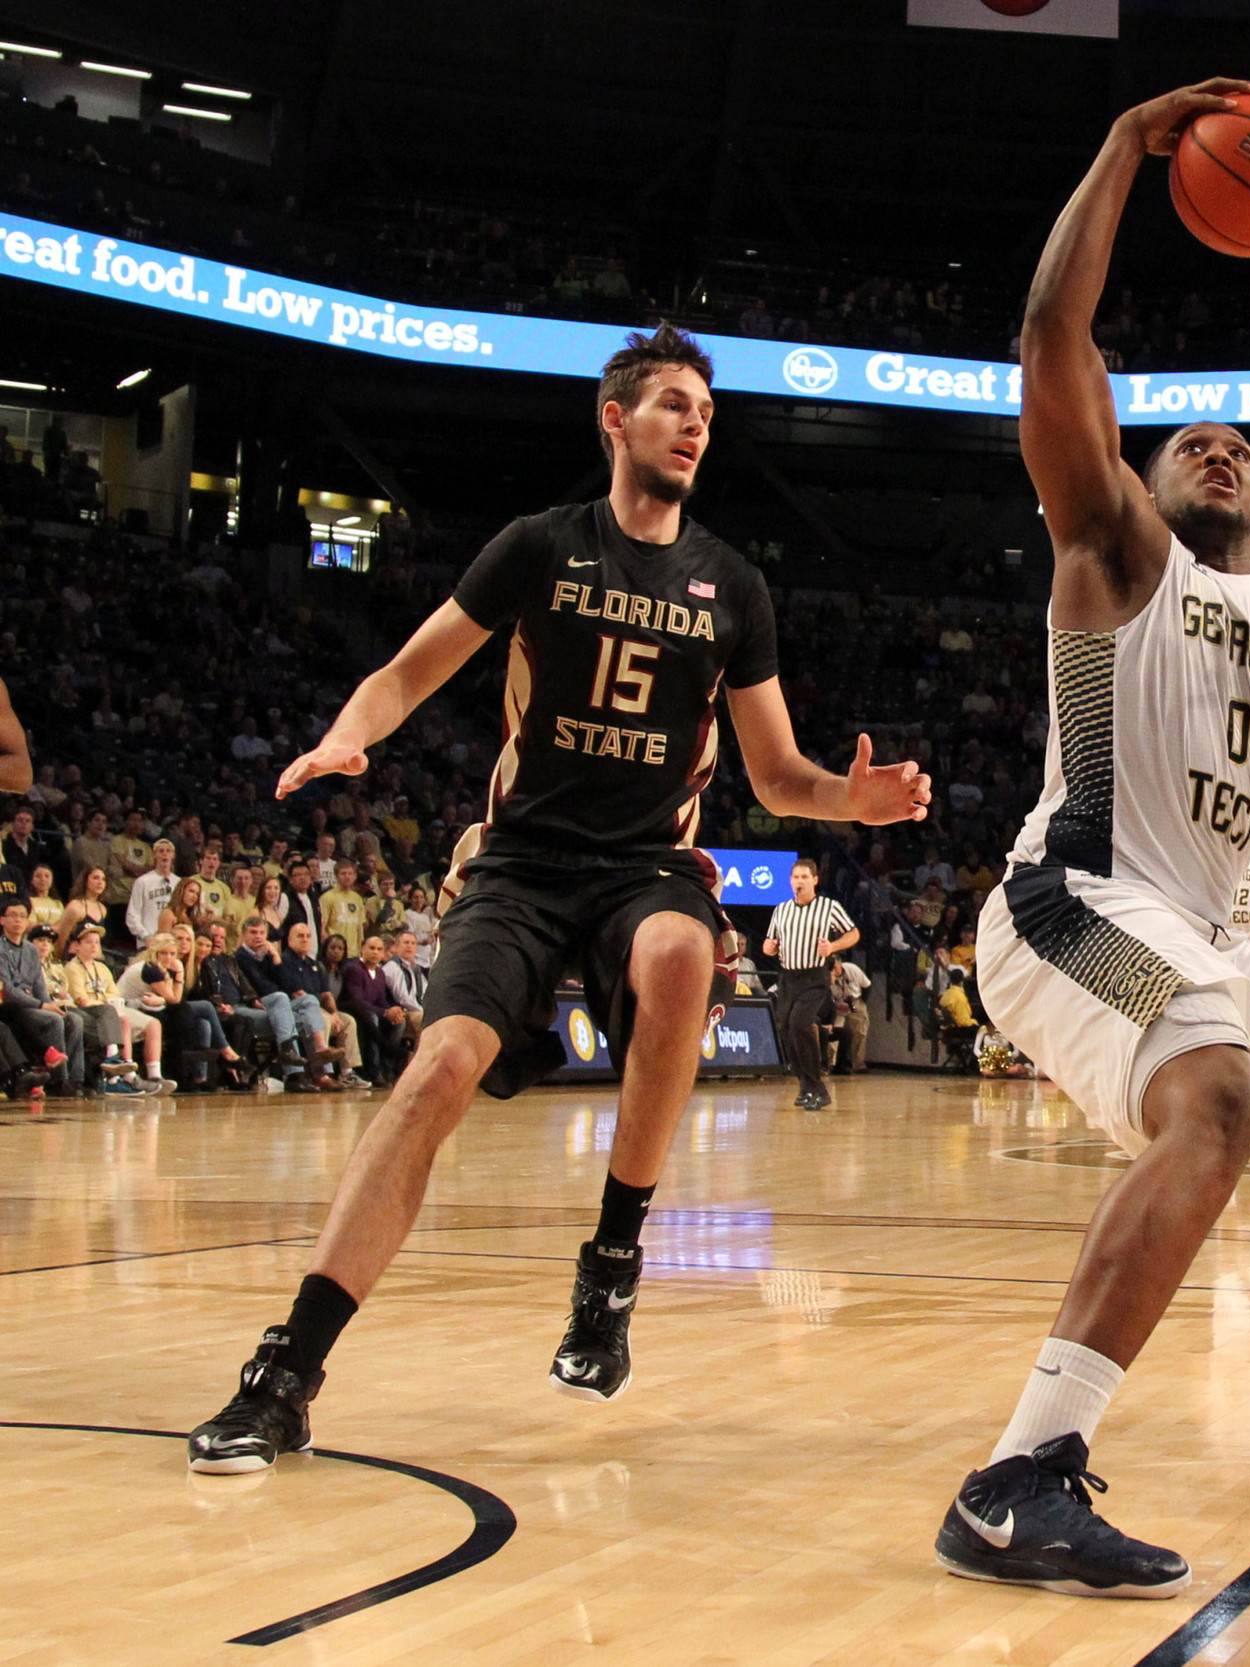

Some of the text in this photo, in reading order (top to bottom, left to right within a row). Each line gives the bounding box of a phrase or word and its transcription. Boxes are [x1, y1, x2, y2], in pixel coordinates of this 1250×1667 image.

[91, 238, 209, 304] food.
[222, 265, 323, 327] Low
[328, 302, 493, 355] prices.
[865, 353, 997, 401] Great
[1128, 375, 1229, 412] Low
[549, 580, 715, 642] FLORIDA
[589, 633, 663, 714] 15
[553, 715, 668, 765] STATE
[1226, 698, 1250, 767] 0
[717, 1024, 750, 1054] bitpay
